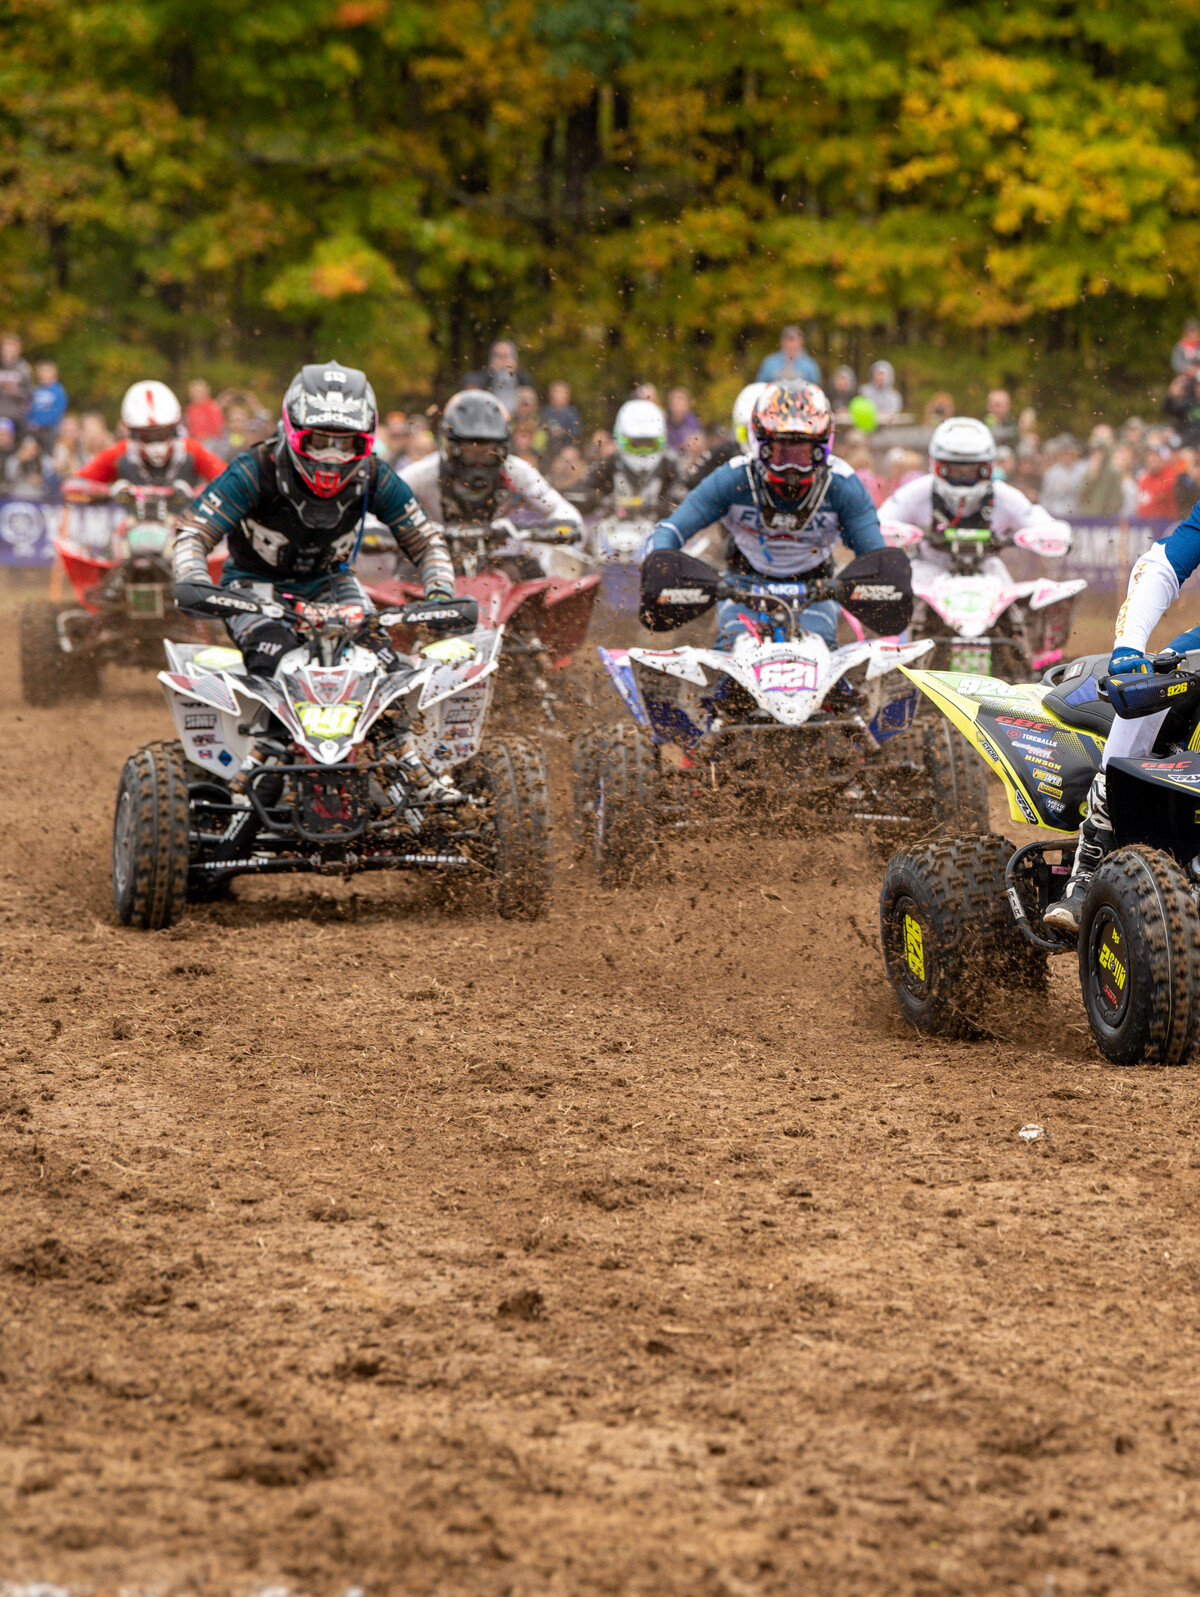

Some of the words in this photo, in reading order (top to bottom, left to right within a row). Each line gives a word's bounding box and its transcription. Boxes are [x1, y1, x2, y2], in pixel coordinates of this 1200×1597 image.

[306, 411, 363, 430] adidas
[957, 677, 1018, 697] 926
[1166, 681, 1188, 698] 926
[994, 715, 1054, 732] GBC
[1022, 733, 1058, 748] TIREBALLS
[981, 741, 999, 762] CYCRA
[1024, 754, 1062, 771] HINSON
[1140, 760, 1193, 769] GBC
[904, 913, 925, 981] 926
